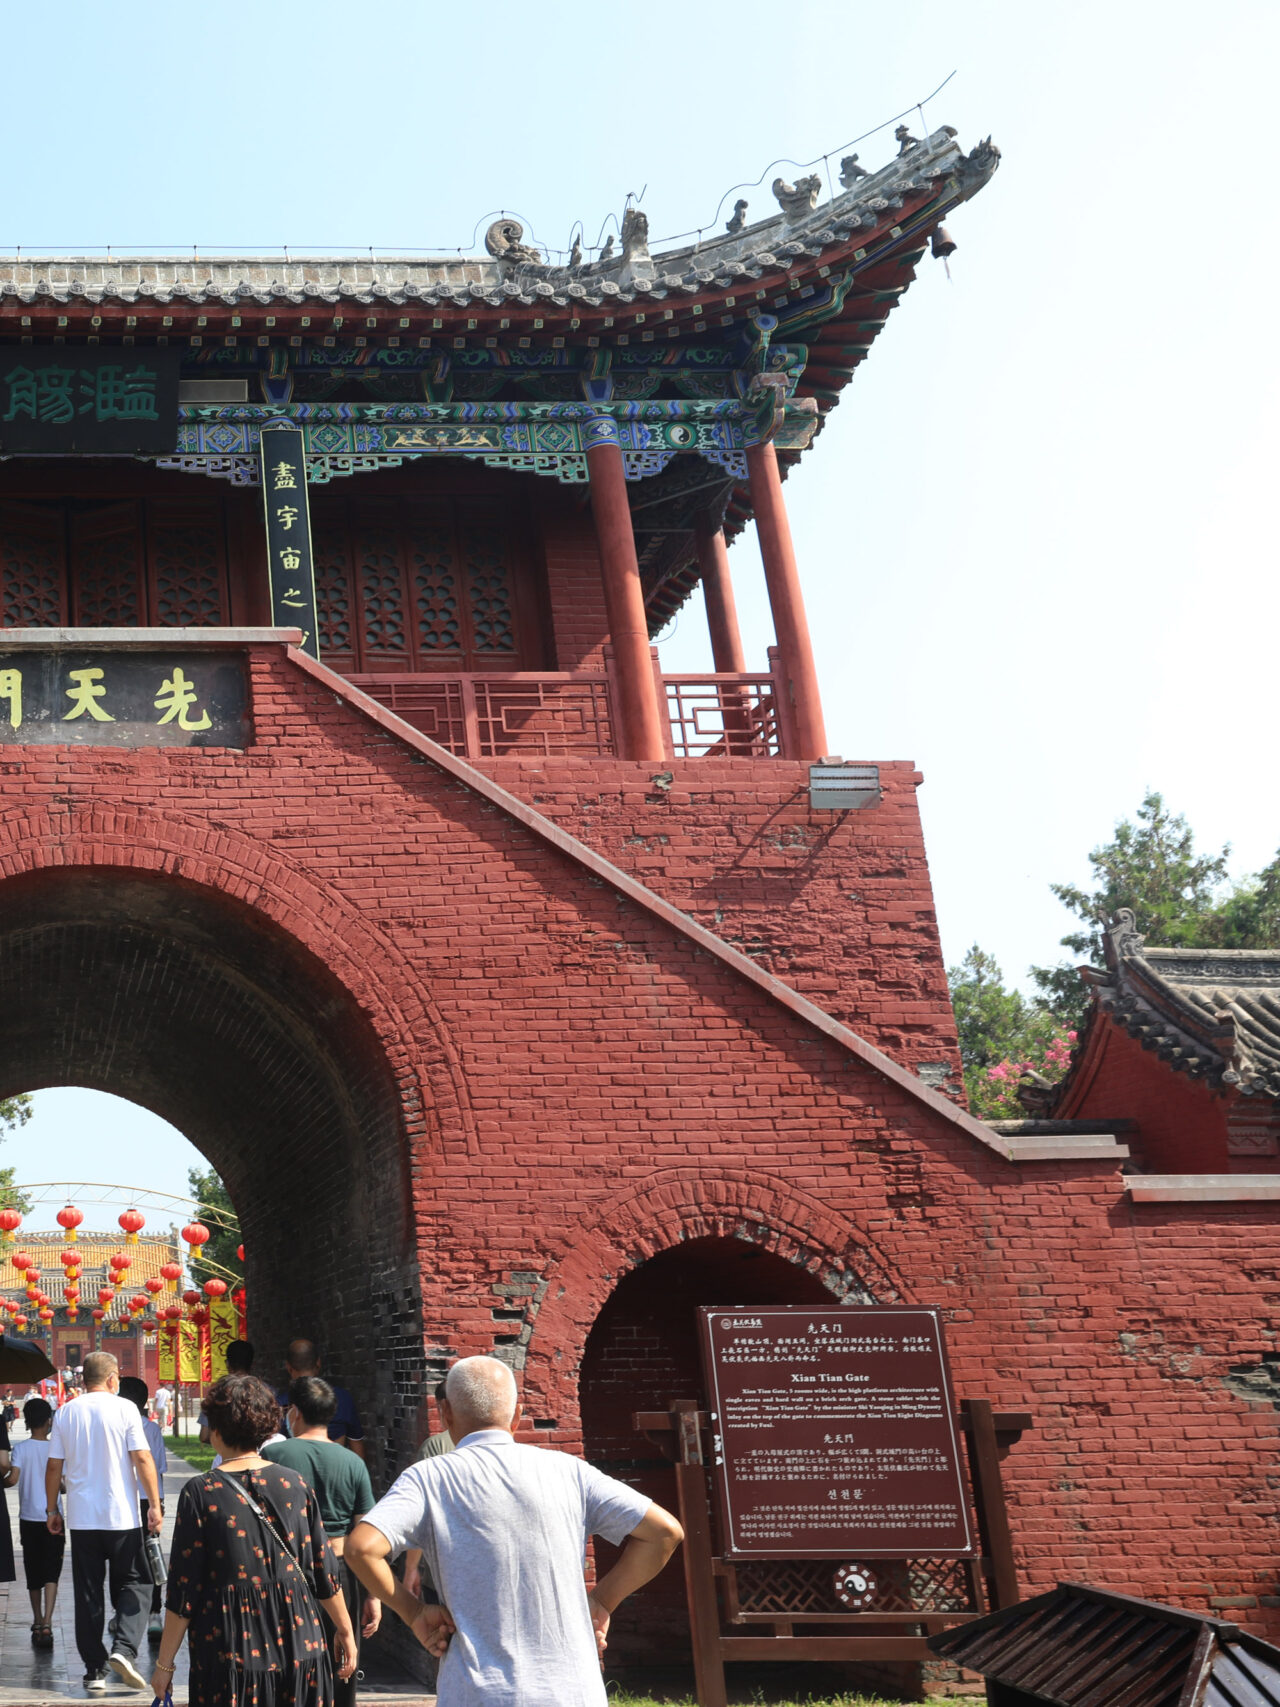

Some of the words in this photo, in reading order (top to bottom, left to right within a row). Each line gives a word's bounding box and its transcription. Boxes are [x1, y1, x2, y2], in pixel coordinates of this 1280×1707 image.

[271, 461, 310, 649] 盡宇宙之
[807, 1322, 843, 1334] 先天门
[791, 1373, 815, 1383] Xian
[818, 1373, 842, 1383] Tian
[844, 1373, 869, 1383] Gate
[823, 1433, 854, 1444] 先天門
